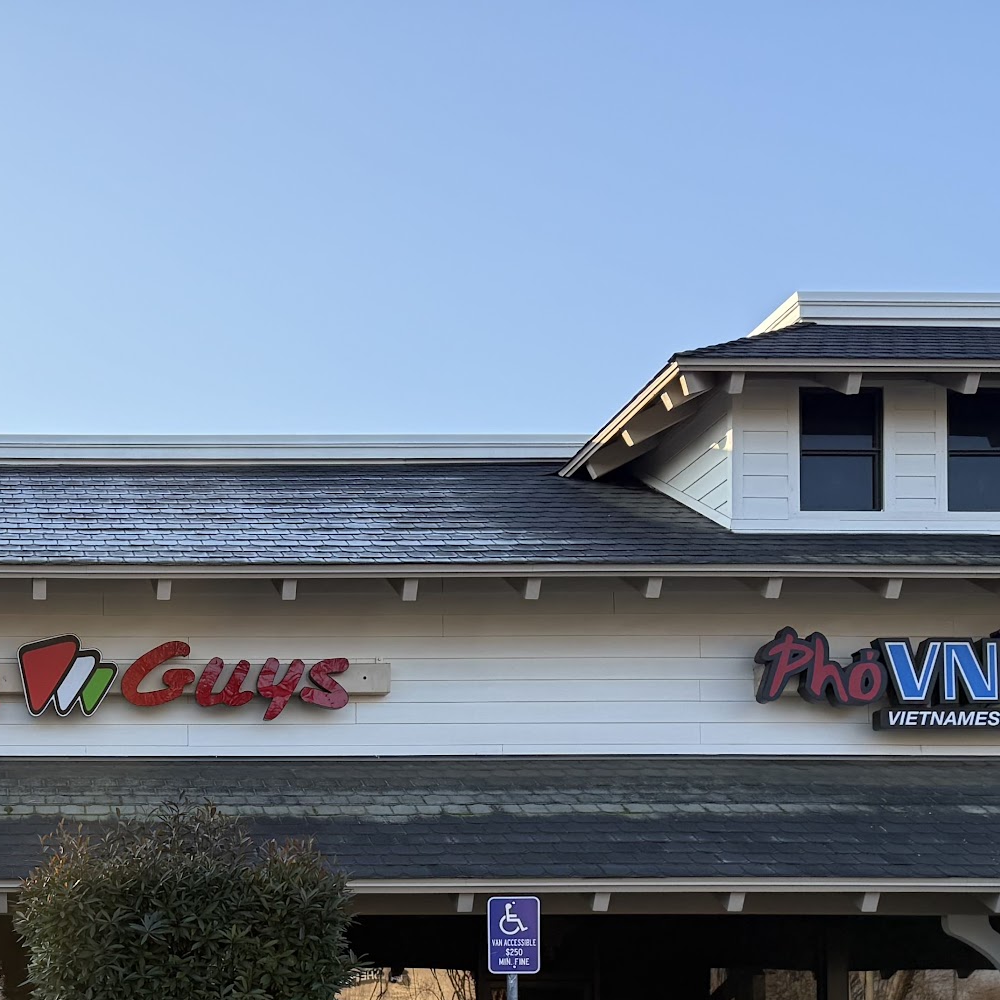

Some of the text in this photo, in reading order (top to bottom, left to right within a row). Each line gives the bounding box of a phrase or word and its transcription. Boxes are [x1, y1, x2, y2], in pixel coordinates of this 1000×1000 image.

[121, 640, 350, 721] Guys
[888, 710, 1000, 726] VIETNAMES
[505, 948, 523, 956] $250
[498, 958, 530, 966] MIN. FINE
